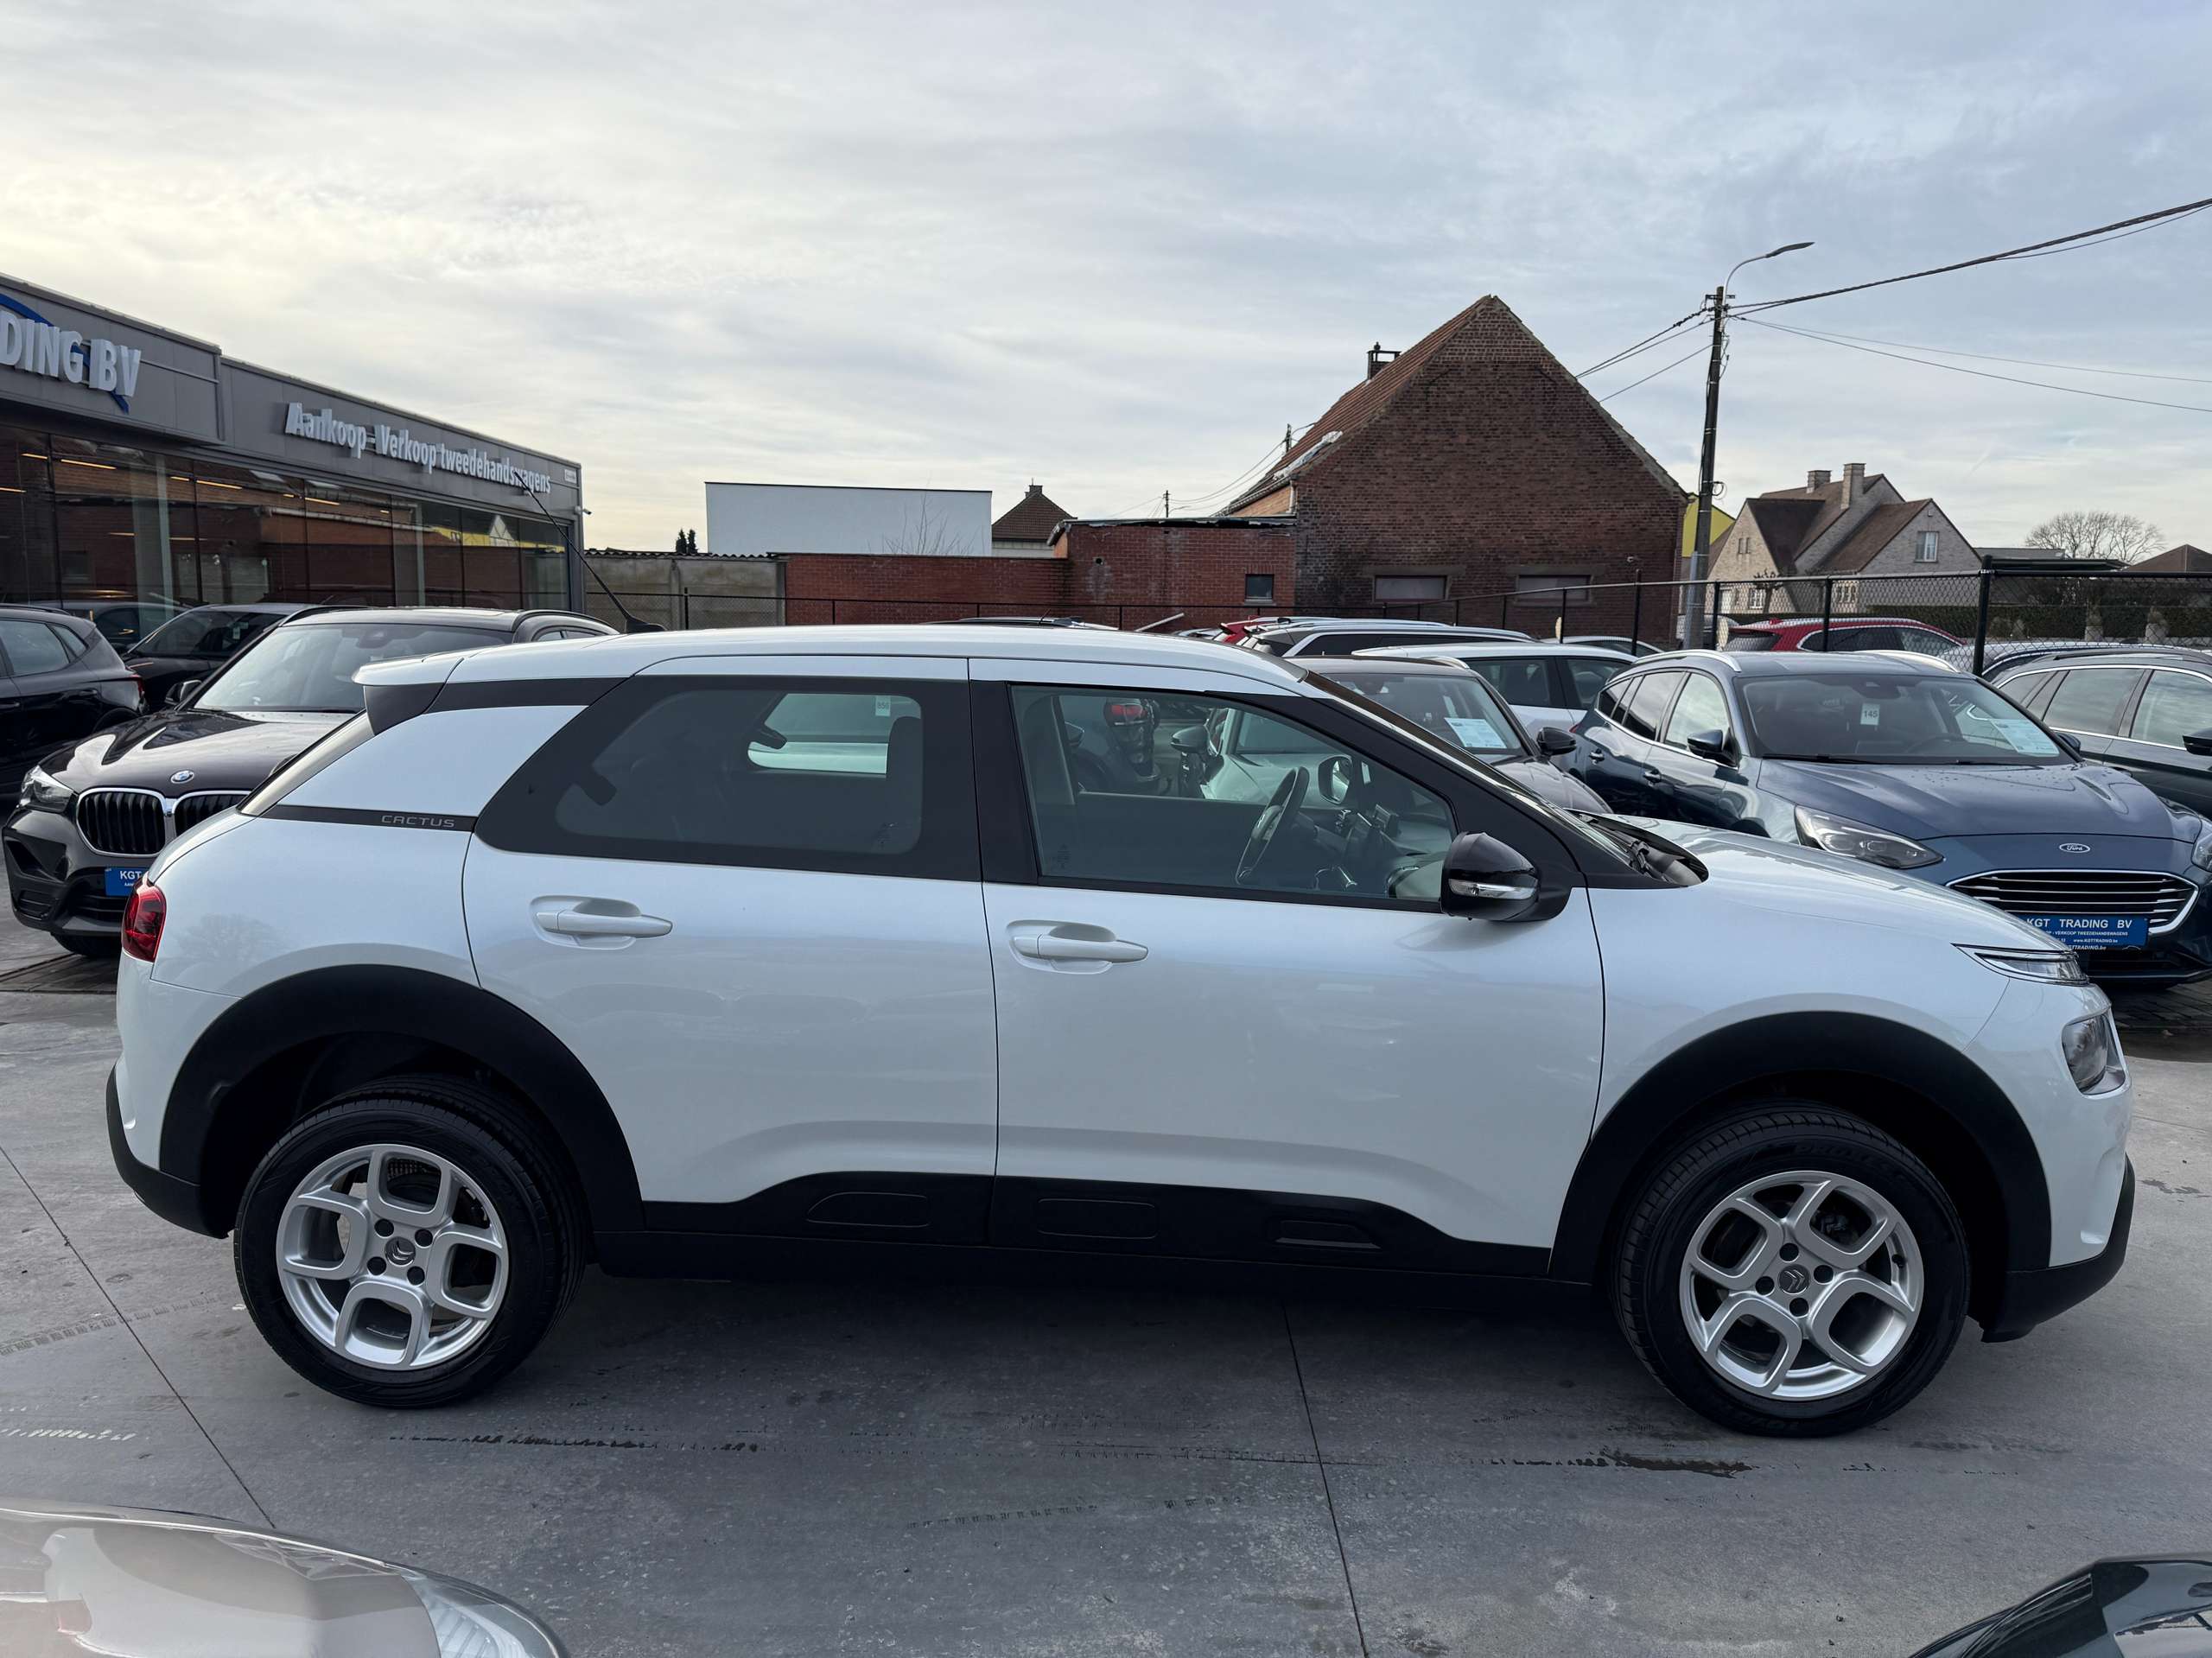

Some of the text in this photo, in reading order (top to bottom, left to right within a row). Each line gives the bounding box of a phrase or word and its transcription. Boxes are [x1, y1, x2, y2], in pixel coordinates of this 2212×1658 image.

[89, 338, 142, 397] BV
[381, 815, 455, 828] CACTUS
[119, 870, 142, 880] KGT
[2059, 918, 2109, 929] TRADING
[2117, 919, 2133, 929] BV
